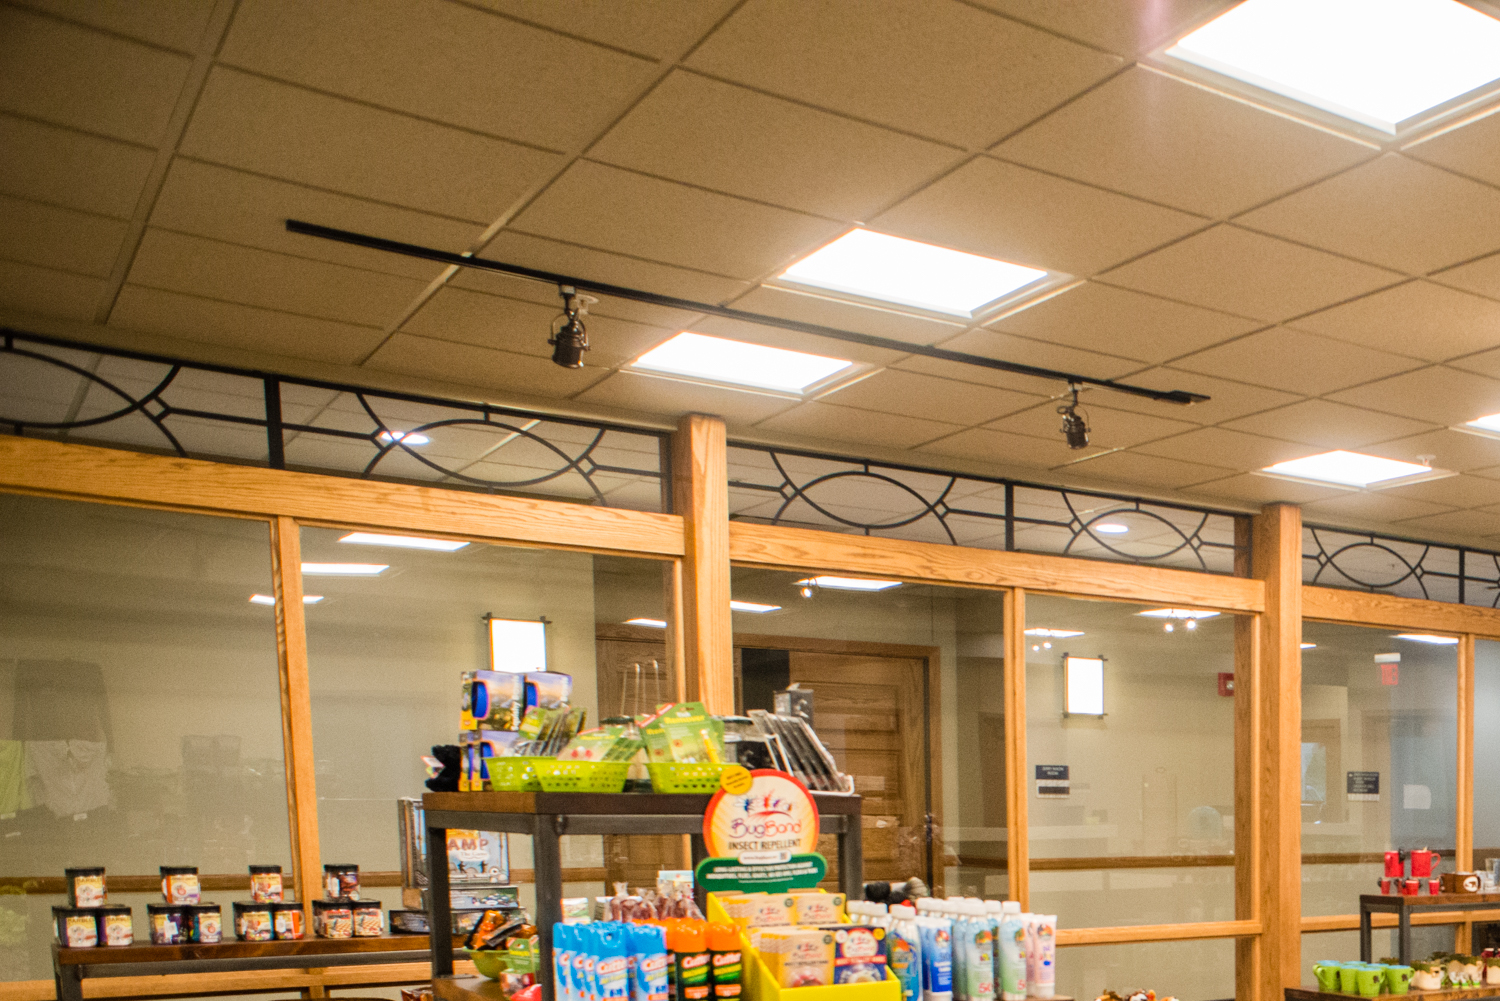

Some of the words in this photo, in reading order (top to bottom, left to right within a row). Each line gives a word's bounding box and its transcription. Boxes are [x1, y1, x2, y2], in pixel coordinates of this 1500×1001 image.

[446, 838, 489, 851] AMP
[728, 841, 758, 851] INSECT
[761, 838, 802, 850] REPELLENT
